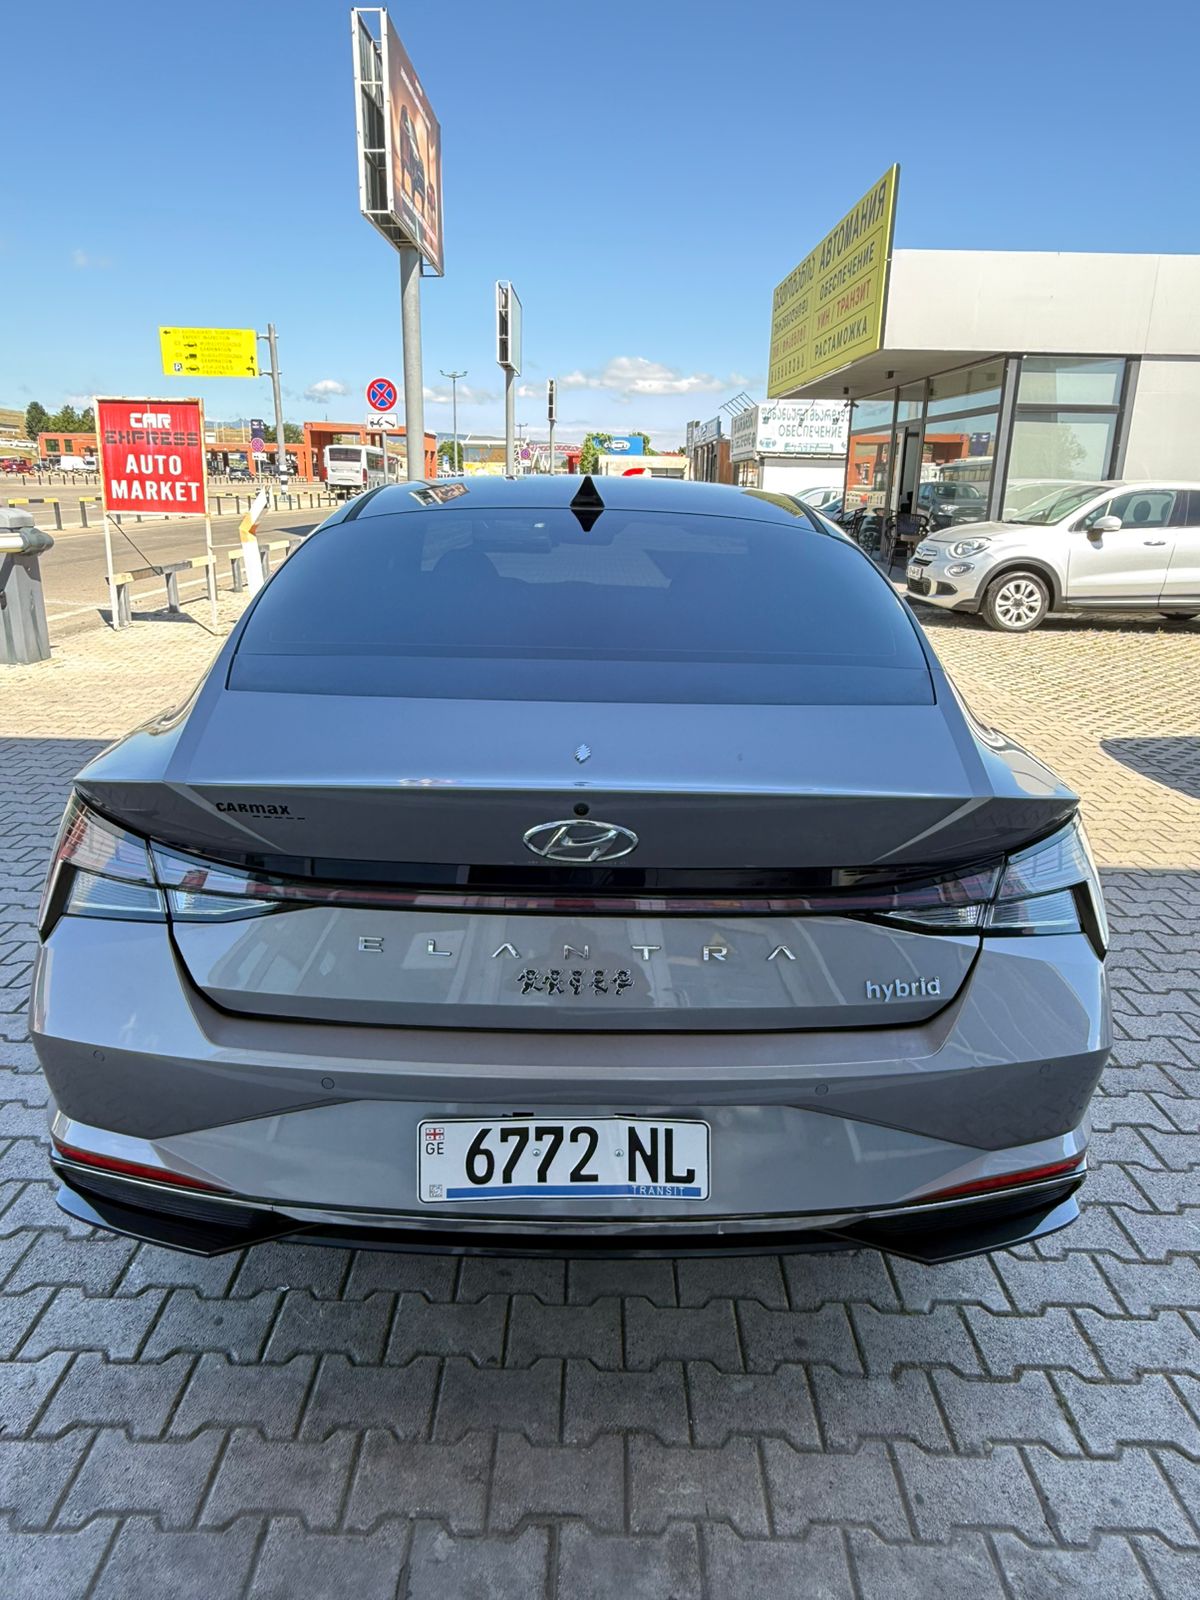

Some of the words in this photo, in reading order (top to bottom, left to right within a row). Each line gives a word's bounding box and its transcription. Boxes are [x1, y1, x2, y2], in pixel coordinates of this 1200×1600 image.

[818, 180, 887, 274] АВТОМАНИЯ
[819, 241, 875, 301] ОБЕСПЕЧЕНИЕ
[836, 278, 872, 318] ТРАНЗИТ
[814, 315, 868, 361] РАСТАМОЖКА
[129, 412, 172, 429] CAR
[778, 424, 844, 439] ОБЕСПЕЧЕНИЕ
[105, 430, 199, 447] EXPRESS
[125, 453, 182, 475] AUTO
[111, 479, 200, 502] MARKET
[358, 936, 797, 963] ELANTRA
[865, 976, 941, 1002] hybrid
[425, 1142, 445, 1155] GE
[464, 1126, 599, 1185] 6772
[627, 1126, 696, 1184] NL
[631, 1186, 686, 1197] TRANSIT
